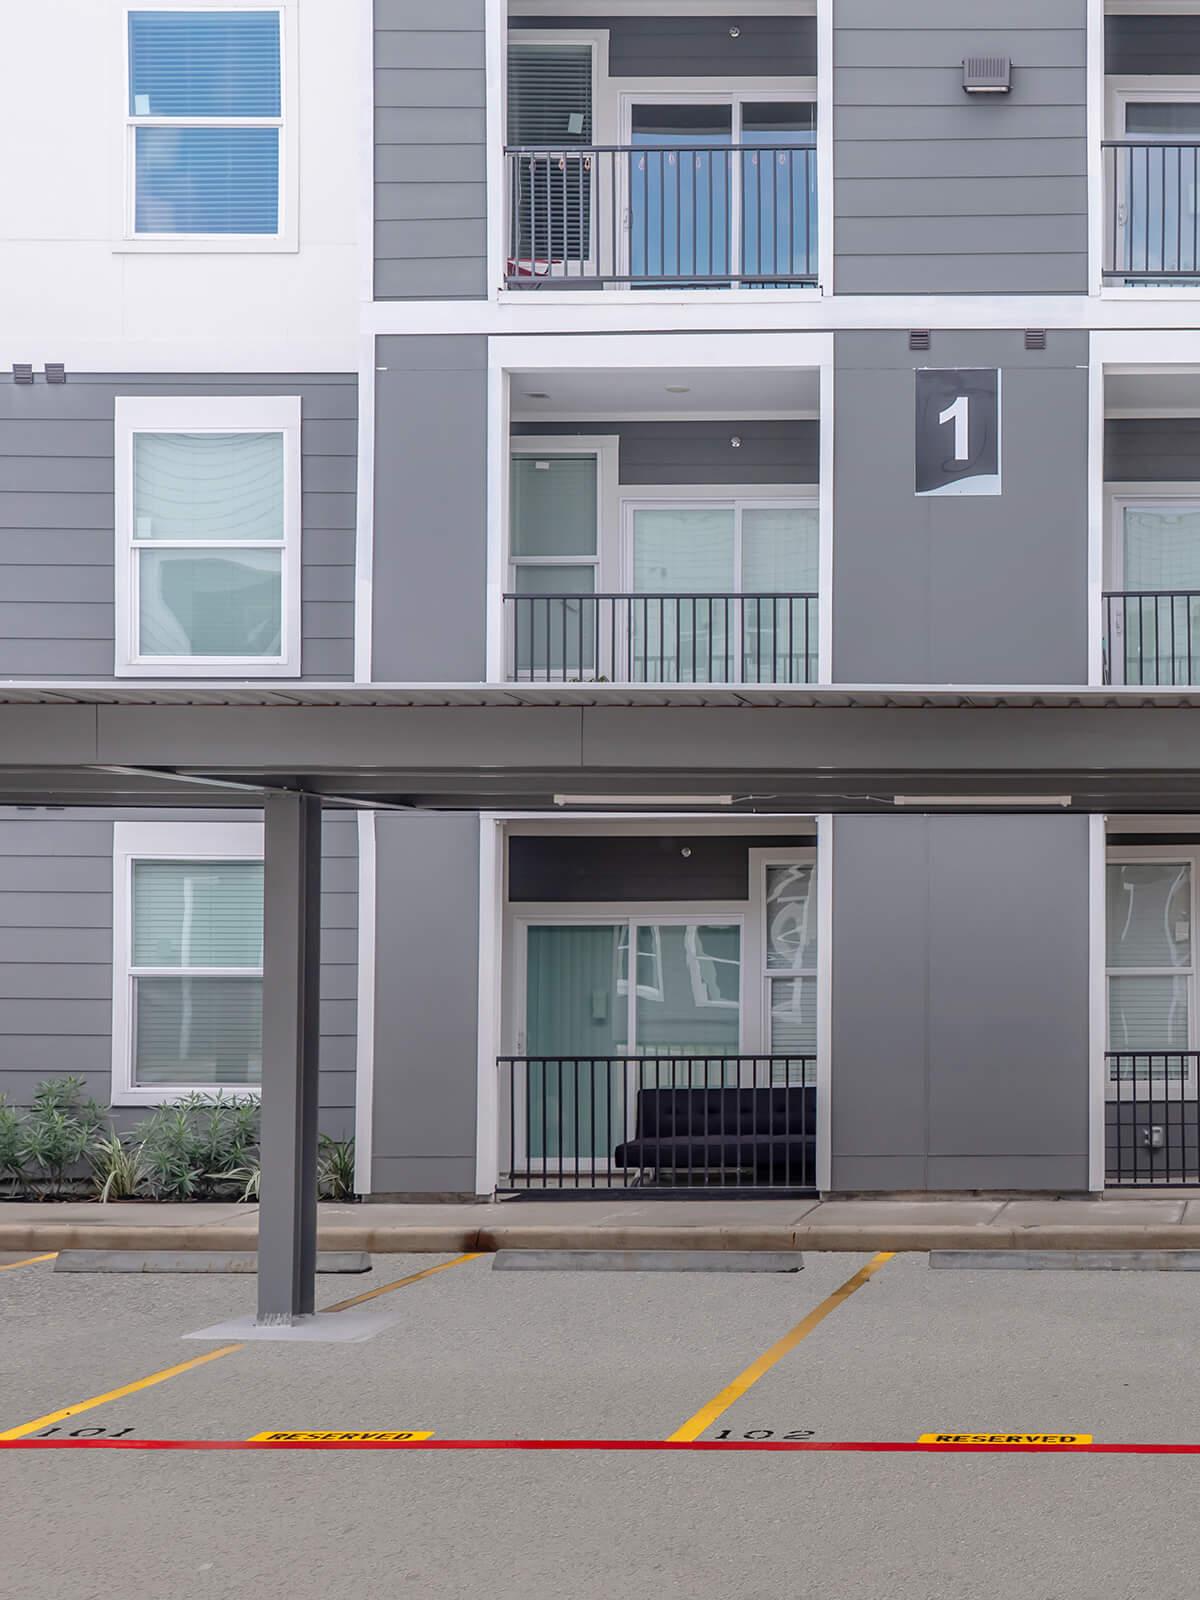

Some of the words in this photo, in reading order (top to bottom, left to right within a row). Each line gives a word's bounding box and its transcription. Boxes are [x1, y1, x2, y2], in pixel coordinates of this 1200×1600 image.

[939, 396, 969, 460] 1
[37, 1427, 135, 1438] 101
[266, 1432, 414, 1441] RESERVED
[715, 1429, 815, 1440] 102
[936, 1434, 1077, 1443] RESERVED
